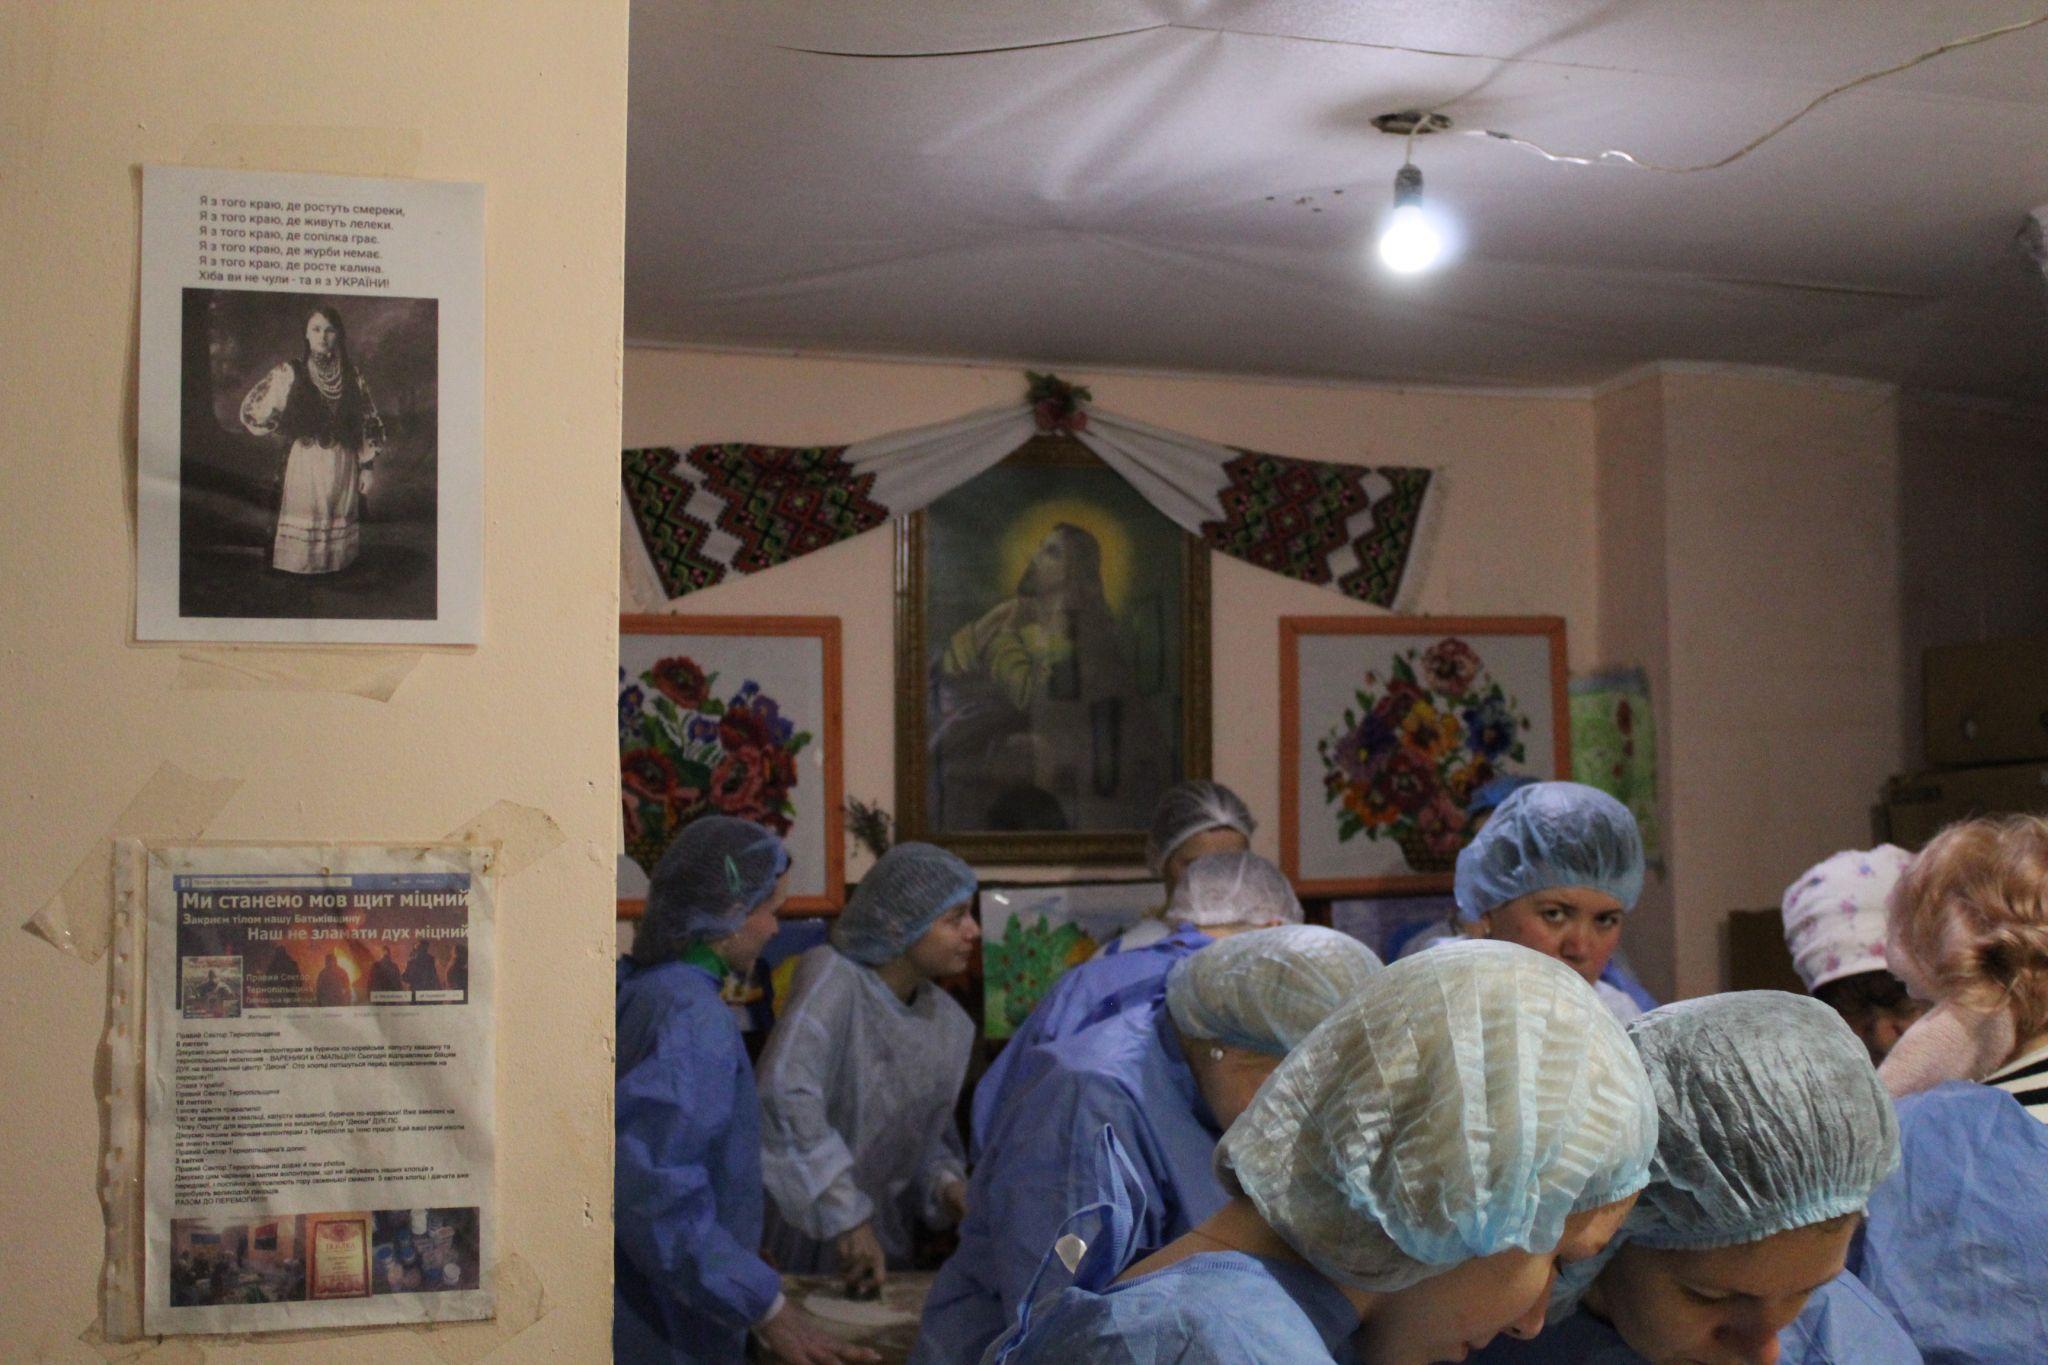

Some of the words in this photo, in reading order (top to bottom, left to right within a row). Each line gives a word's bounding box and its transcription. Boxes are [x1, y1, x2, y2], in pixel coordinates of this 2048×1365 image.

[199, 195, 208, 206] Я
[210, 198, 217, 206] з
[221, 198, 246, 208] того
[286, 201, 301, 211] де
[304, 203, 350, 215] ростуть
[199, 210, 208, 220] Я
[210, 213, 217, 221] з
[221, 213, 246, 223] того
[286, 216, 301, 226] де
[304, 217, 346, 229] живуть
[199, 225, 208, 236] Я
[210, 228, 217, 236] з
[221, 229, 246, 238] того
[286, 231, 301, 241] де
[304, 232, 348, 242] сопілка
[199, 241, 207, 250] Я
[210, 243, 217, 251] з
[221, 243, 246, 252] того
[286, 246, 301, 256] де
[304, 246, 340, 259] журби
[199, 255, 207, 265] Я
[210, 258, 217, 266] з
[221, 258, 246, 268] того
[286, 261, 301, 271] де
[303, 262, 337, 273] росте
[199, 270, 224, 282] Хіба
[227, 273, 241, 281] ви
[245, 274, 259, 283] не
[262, 275, 289, 286] чули
[299, 277, 312, 285] та
[325, 278, 332, 286] з
[182, 892, 212, 909] Ми
[218, 894, 303, 909] станемо
[309, 894, 347, 908] мов
[353, 893, 395, 910] щит
[400, 888, 469, 910] міцний
[232, 913, 262, 925] тілом
[264, 915, 292, 926] нашу
[247, 927, 283, 941] Наш
[287, 927, 309, 940] не
[311, 927, 377, 940] зламати
[381, 927, 410, 941] дух
[415, 924, 468, 941] міцний
